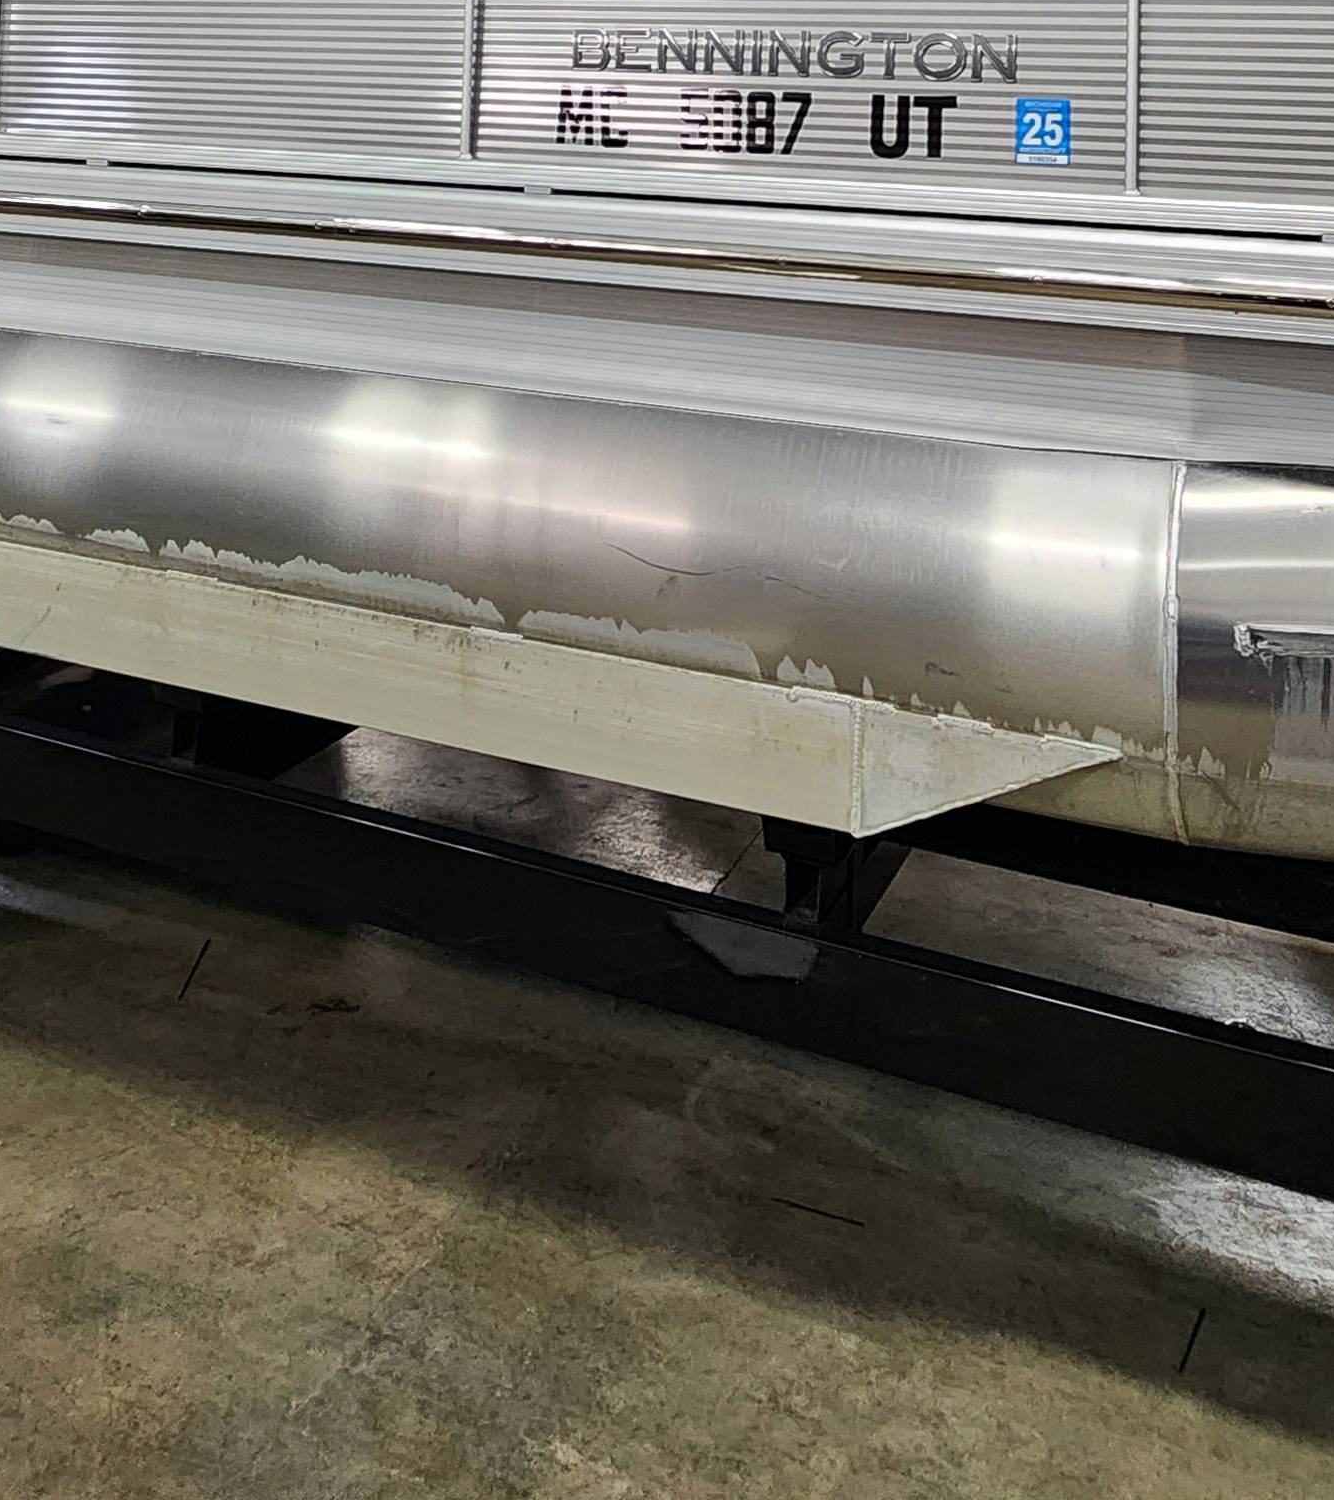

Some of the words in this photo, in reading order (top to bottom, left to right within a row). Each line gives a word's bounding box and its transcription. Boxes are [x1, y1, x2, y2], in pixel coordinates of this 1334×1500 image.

[571, 27, 1018, 84] BENNINGTON
[555, 85, 629, 149] MC
[870, 94, 958, 159] UT
[1021, 112, 1064, 147] 25
